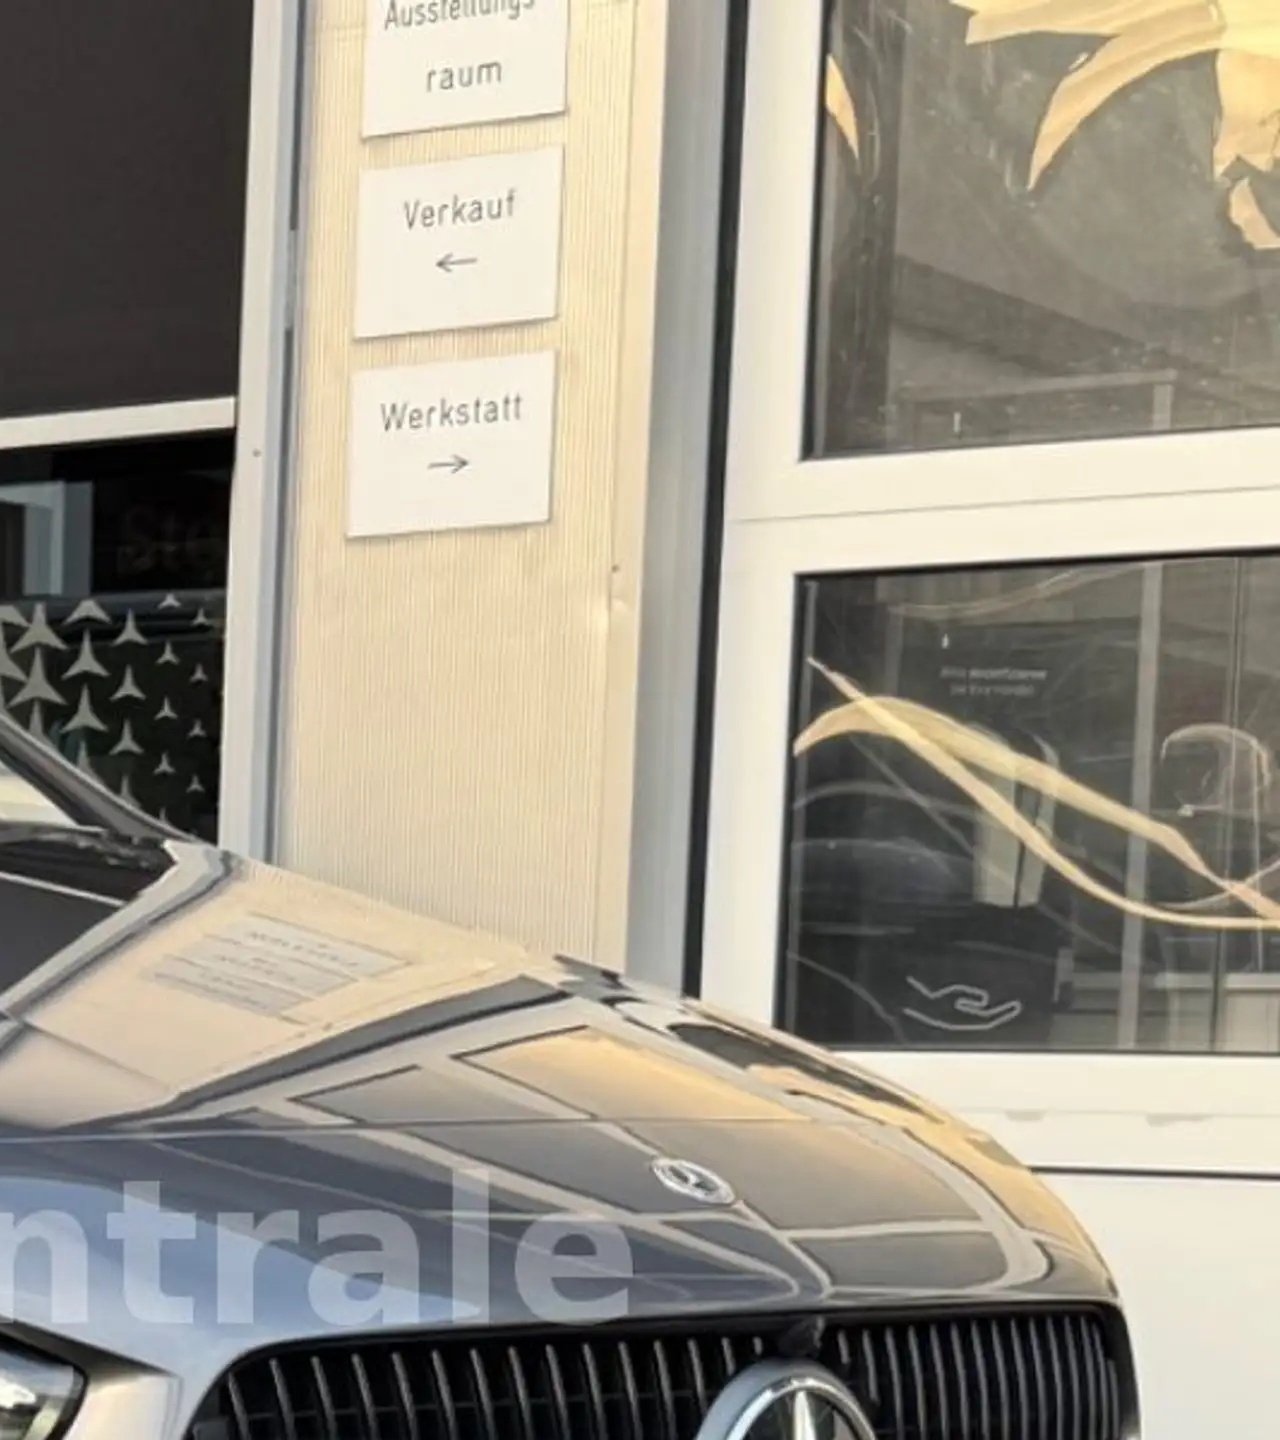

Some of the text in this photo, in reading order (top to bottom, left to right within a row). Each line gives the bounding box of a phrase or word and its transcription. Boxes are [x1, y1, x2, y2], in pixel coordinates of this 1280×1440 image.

[426, 61, 502, 92] raum
[403, 187, 516, 231] Verkauf
[380, 392, 522, 432] Werkstatt
